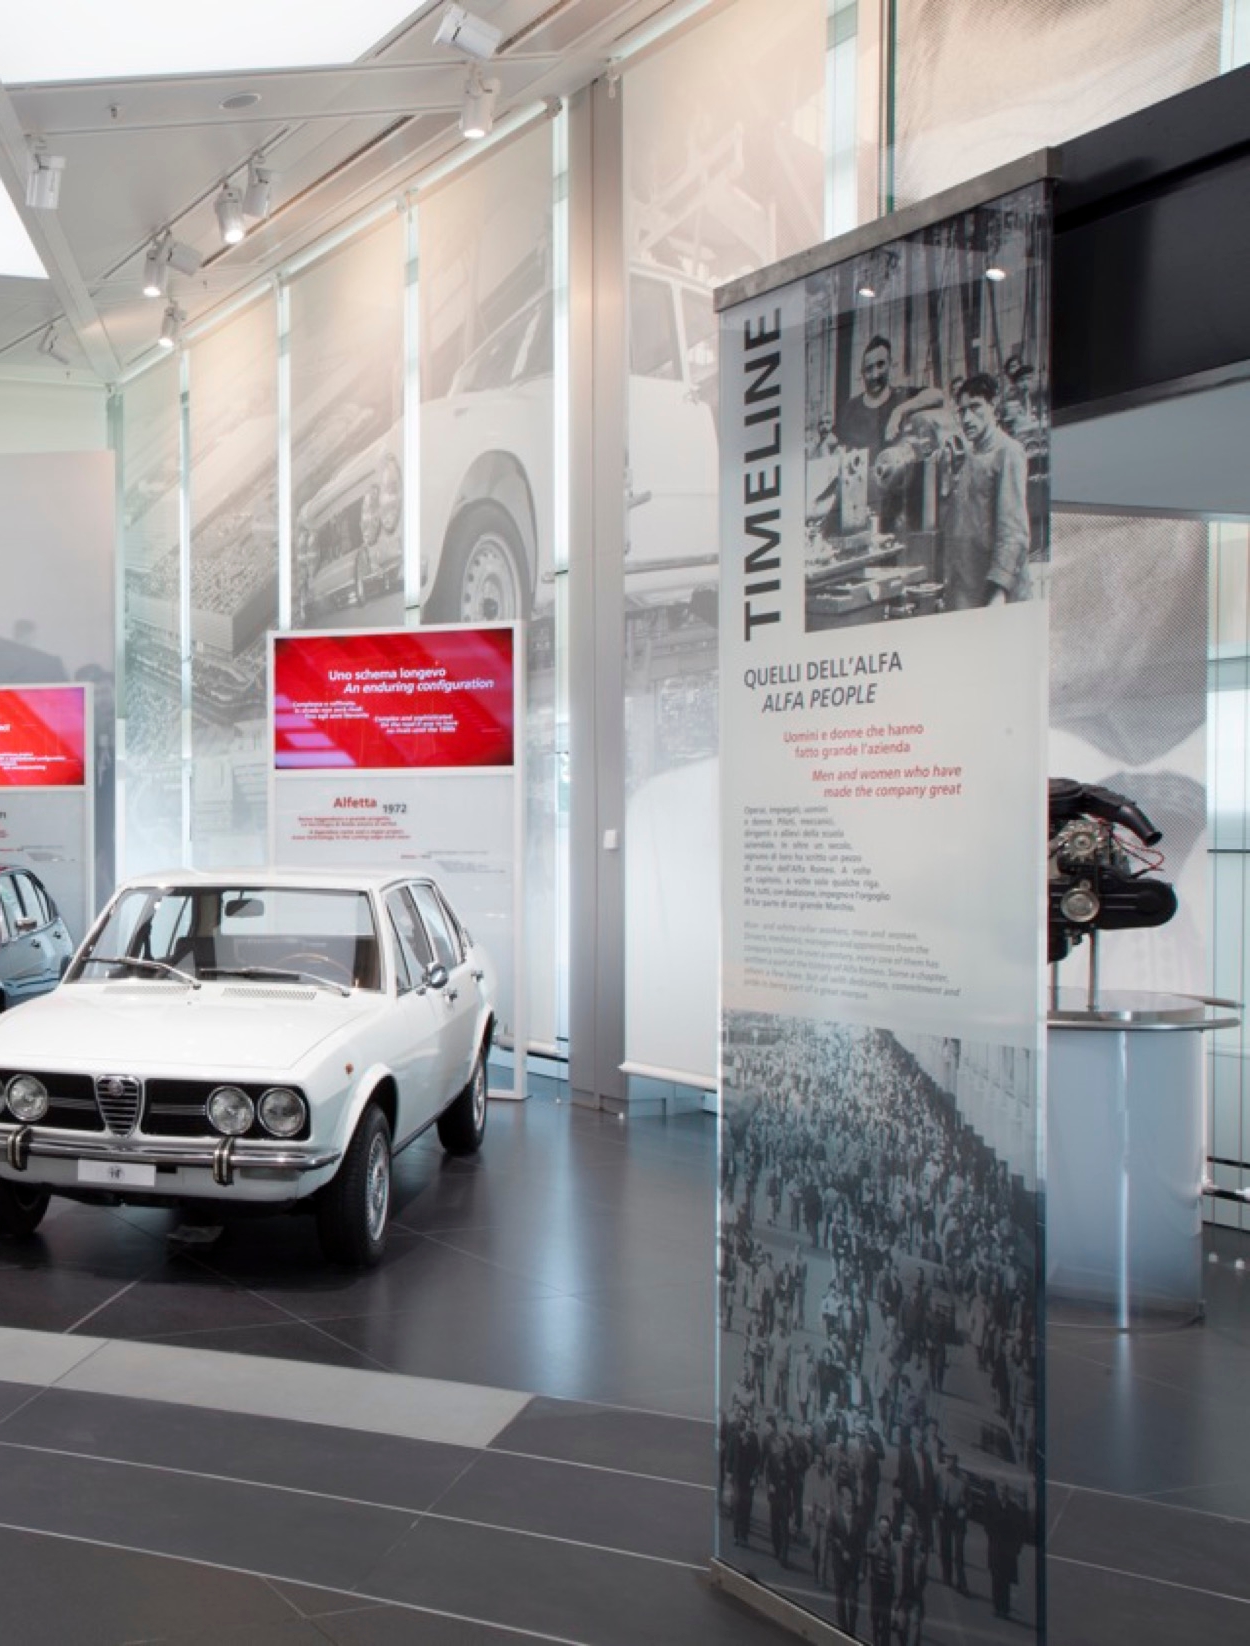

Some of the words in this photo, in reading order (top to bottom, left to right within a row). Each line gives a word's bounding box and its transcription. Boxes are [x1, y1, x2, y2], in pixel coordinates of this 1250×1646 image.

[744, 308, 782, 642] TIMELINE
[329, 670, 352, 680] Uno
[355, 668, 397, 680] schema
[400, 667, 446, 682] longevo
[744, 663, 801, 689] QUELLI
[344, 683, 359, 693] An
[363, 681, 414, 695] enduring
[417, 678, 494, 692] configuration
[762, 691, 804, 713] ALFA
[810, 683, 877, 709] PEOPLE
[783, 731, 818, 743] Uomini
[821, 733, 827, 741] e
[830, 728, 863, 740] donne
[866, 725, 884, 737] che
[888, 723, 924, 736] hanno
[795, 746, 819, 758] fatto
[822, 743, 858, 759] grande
[812, 770, 834, 781] Men
[837, 769, 858, 781] and
[860, 769, 901, 780] women
[904, 765, 929, 778] who
[933, 765, 962, 777] have
[824, 786, 852, 797] made
[855, 786, 872, 797] the
[875, 784, 926, 799] company
[930, 782, 962, 798] great
[333, 797, 377, 808] Alfetta
[383, 804, 407, 814] 1972
